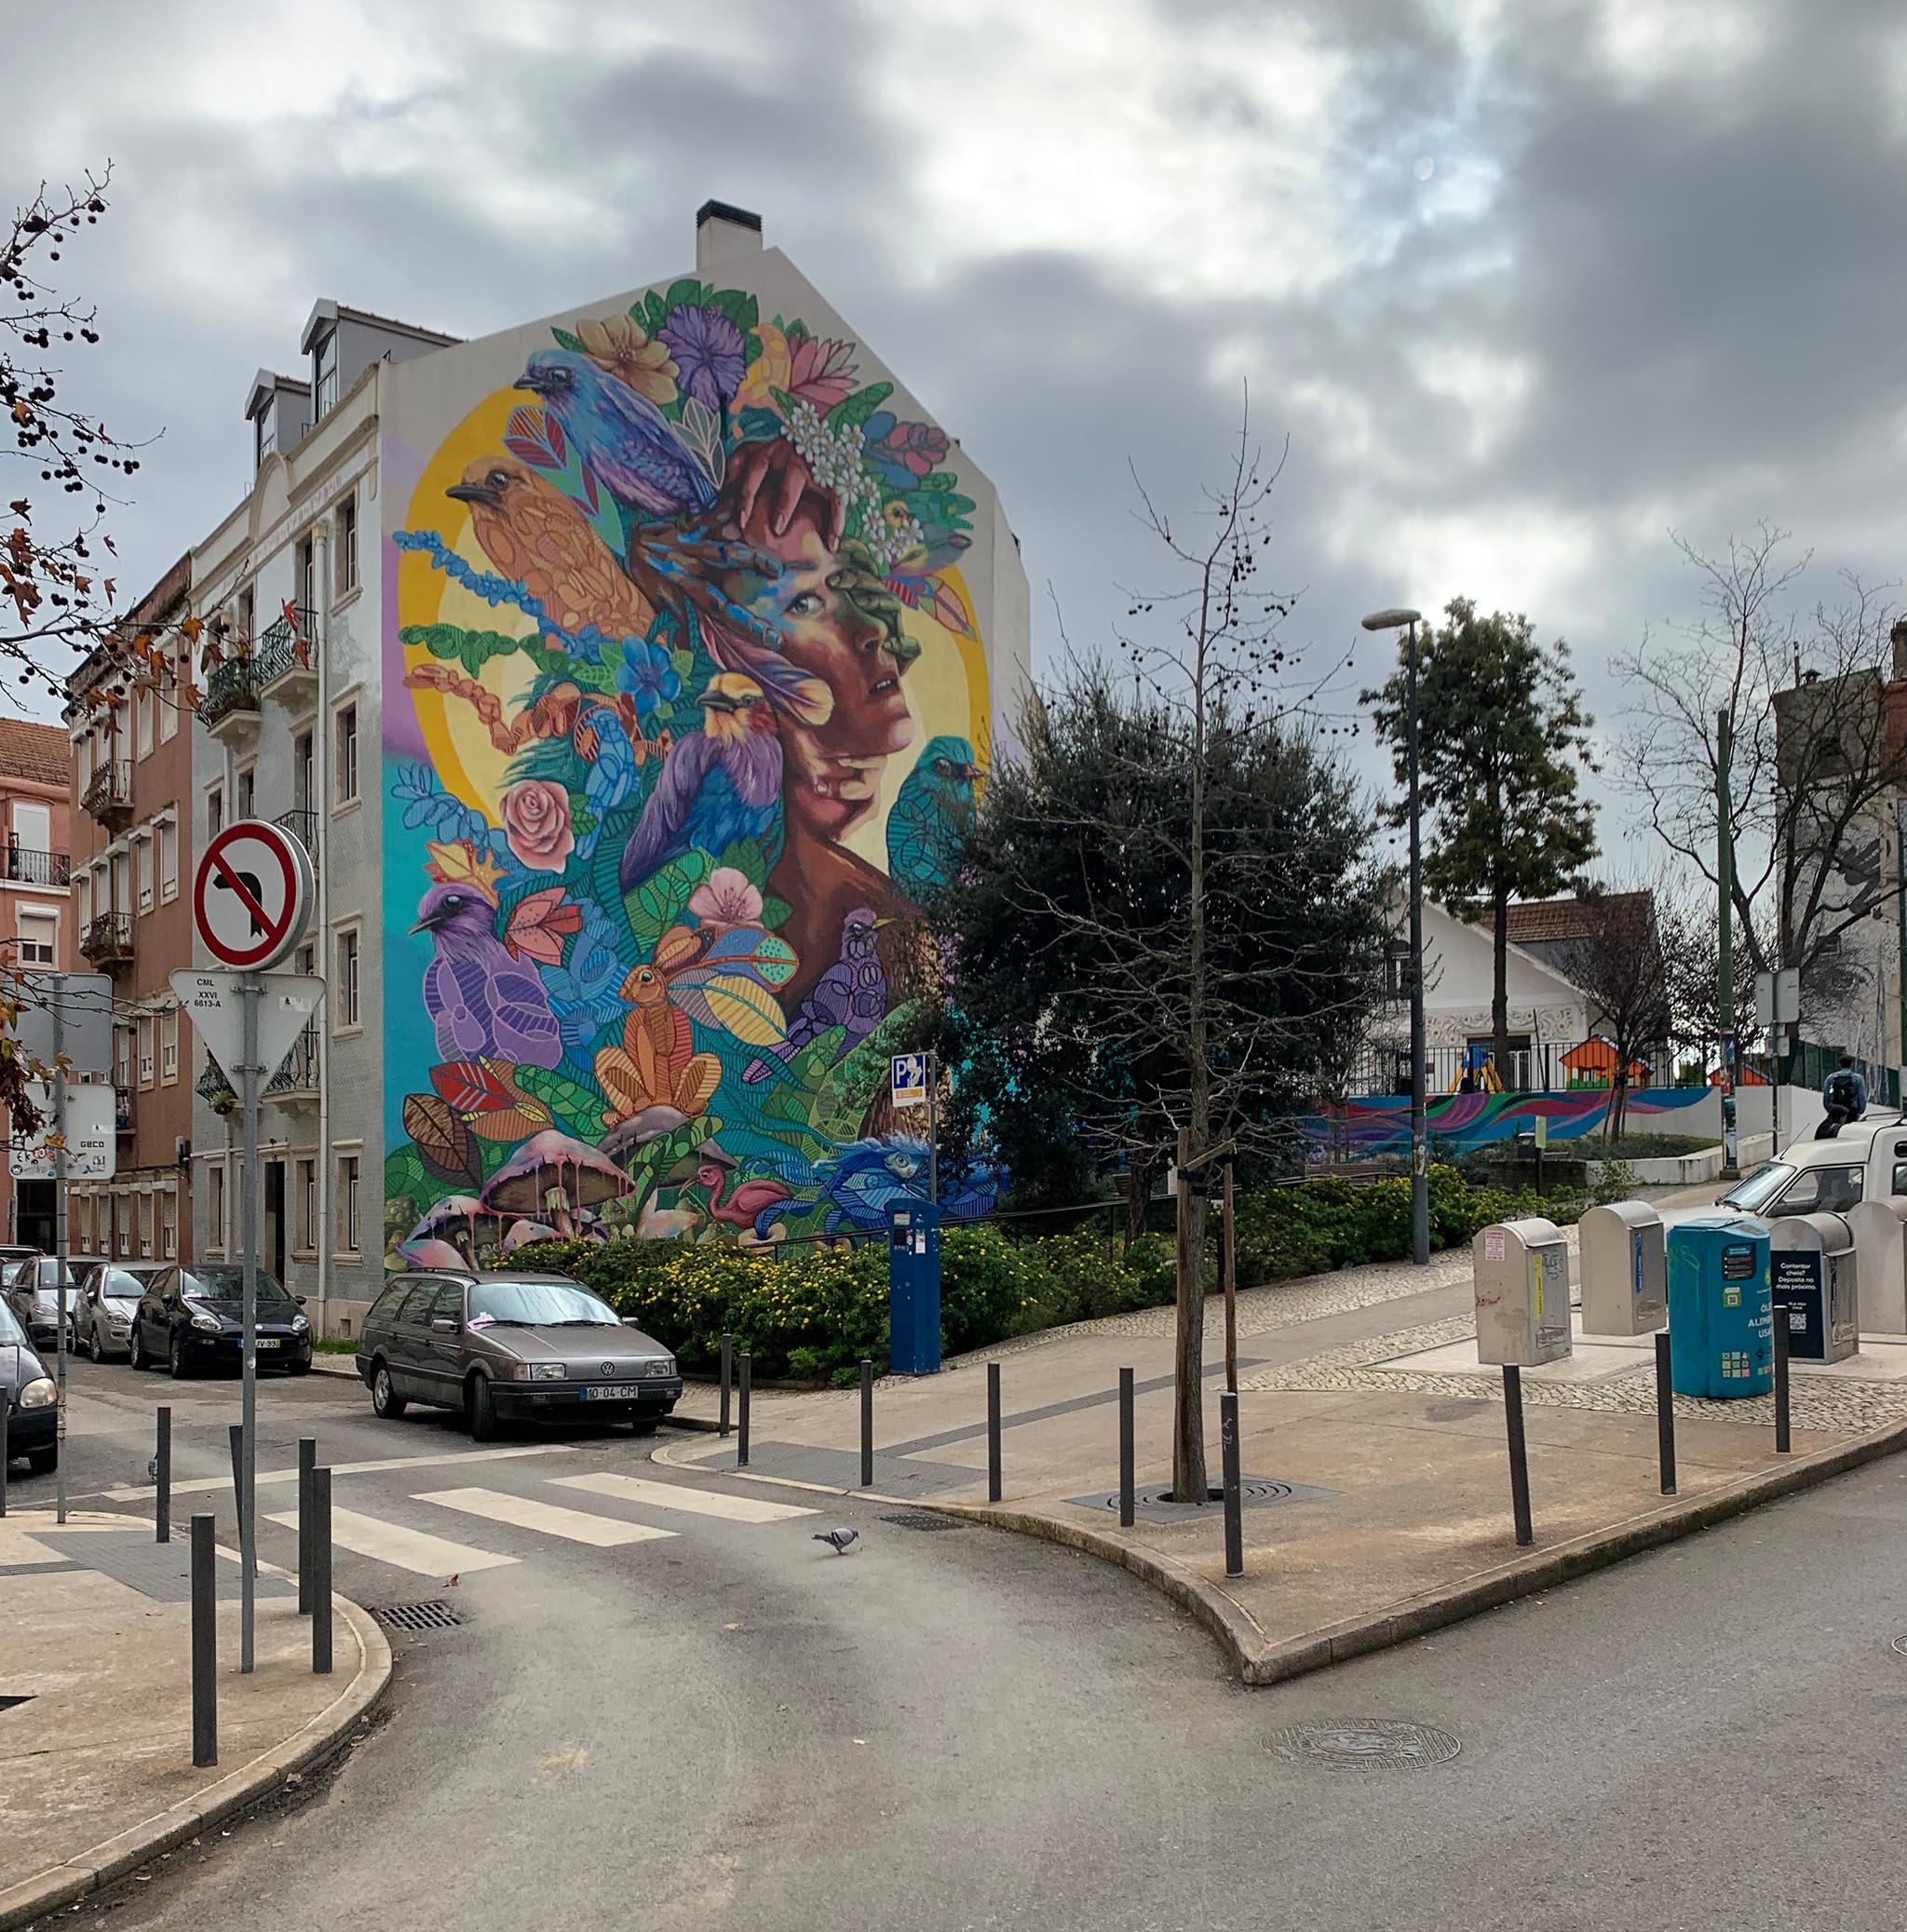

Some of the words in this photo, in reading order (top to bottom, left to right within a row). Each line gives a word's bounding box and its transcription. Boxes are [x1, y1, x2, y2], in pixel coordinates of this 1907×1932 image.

[194, 999, 222, 1007] 6613-A
[896, 1060, 907, 1085] P
[588, 1386, 637, 1398] 10-04-CM
